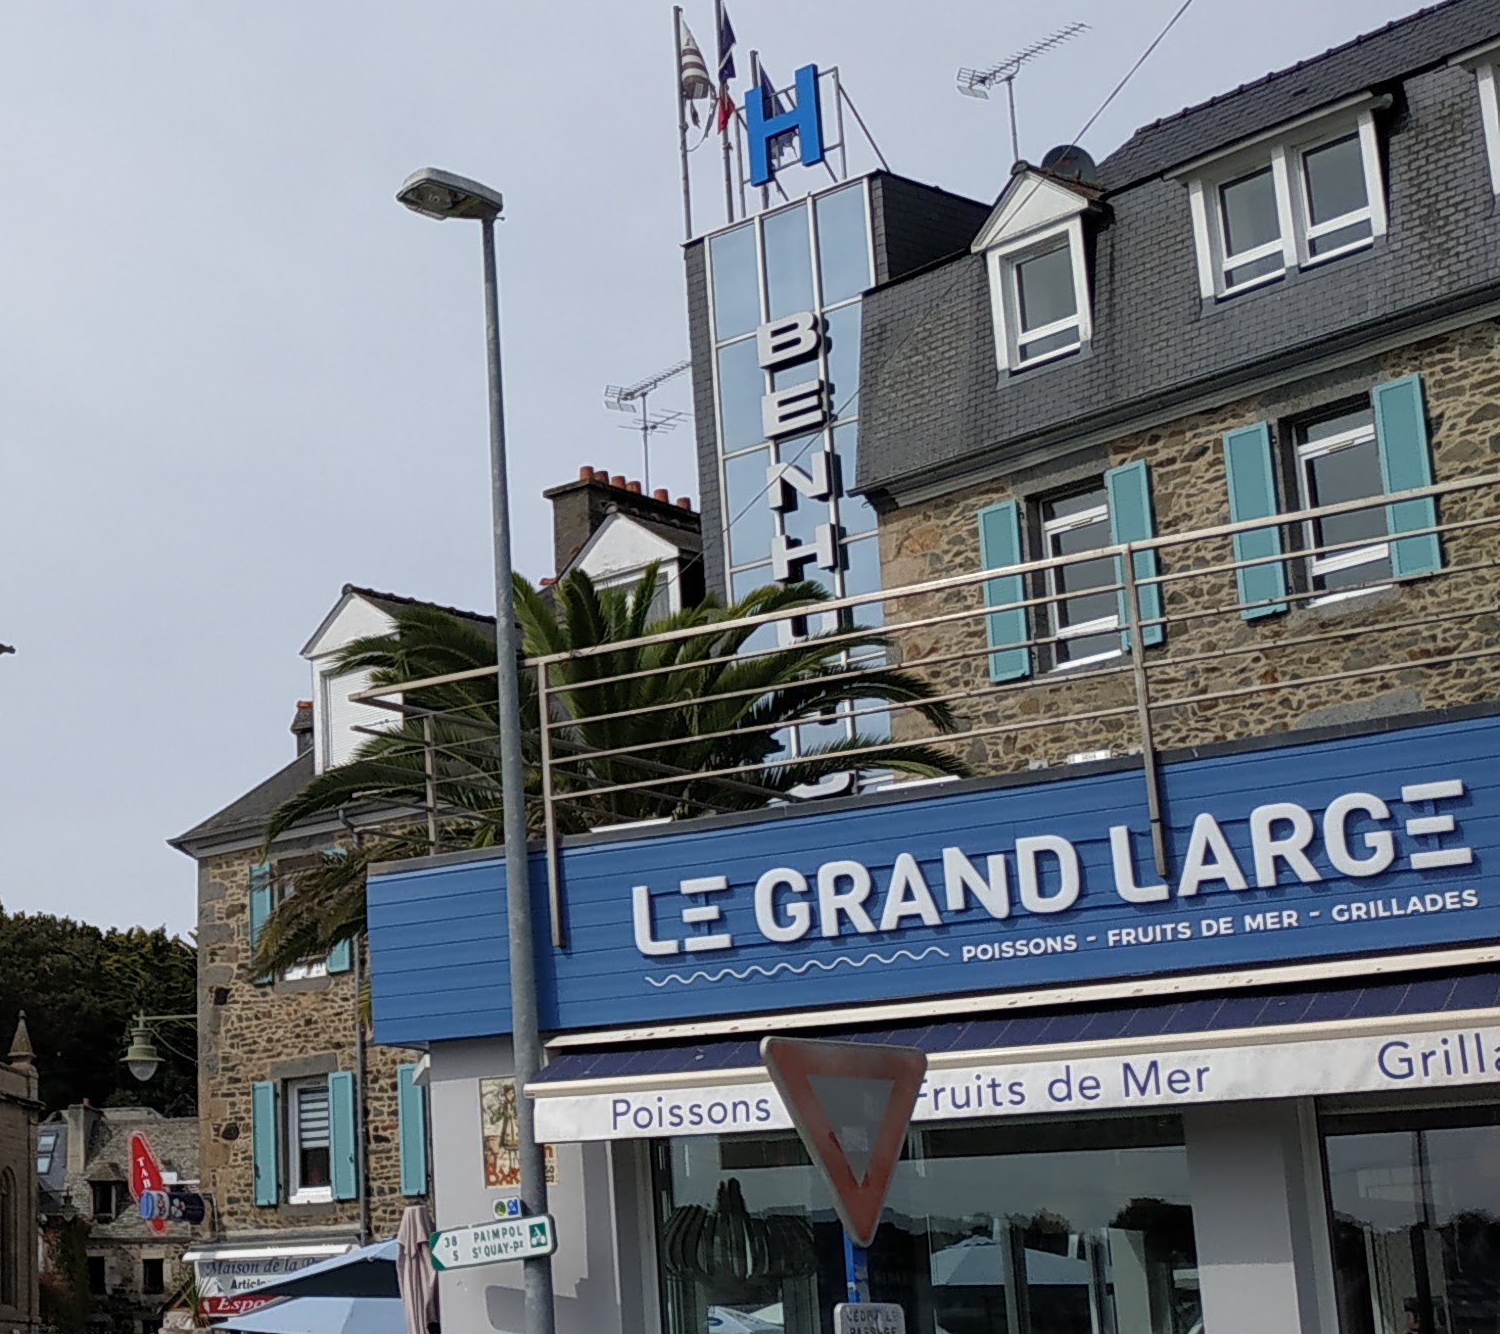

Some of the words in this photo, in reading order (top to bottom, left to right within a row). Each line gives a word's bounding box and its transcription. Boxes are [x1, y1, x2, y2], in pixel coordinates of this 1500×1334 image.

[745, 64, 824, 186] H
[632, 875, 734, 956] LE
[754, 834, 1080, 943] GRAND
[1108, 778, 1474, 903] LARGE
[962, 934, 1077, 962] POISSONS
[1107, 922, 1192, 947] FRUITS
[1202, 917, 1234, 938] DE
[1245, 910, 1299, 933] MER
[1332, 889, 1479, 923] GRILLADES
[612, 1097, 772, 1131] Poissons
[1047, 1065, 1101, 1103] de
[1122, 1059, 1210, 1098] Mer
[206, 1260, 259, 1275] Maison
[263, 1257, 279, 1272] de
[282, 1257, 297, 1272] la
[444, 1235, 457, 1248] 38
[473, 1228, 523, 1243] PAIMPOL
